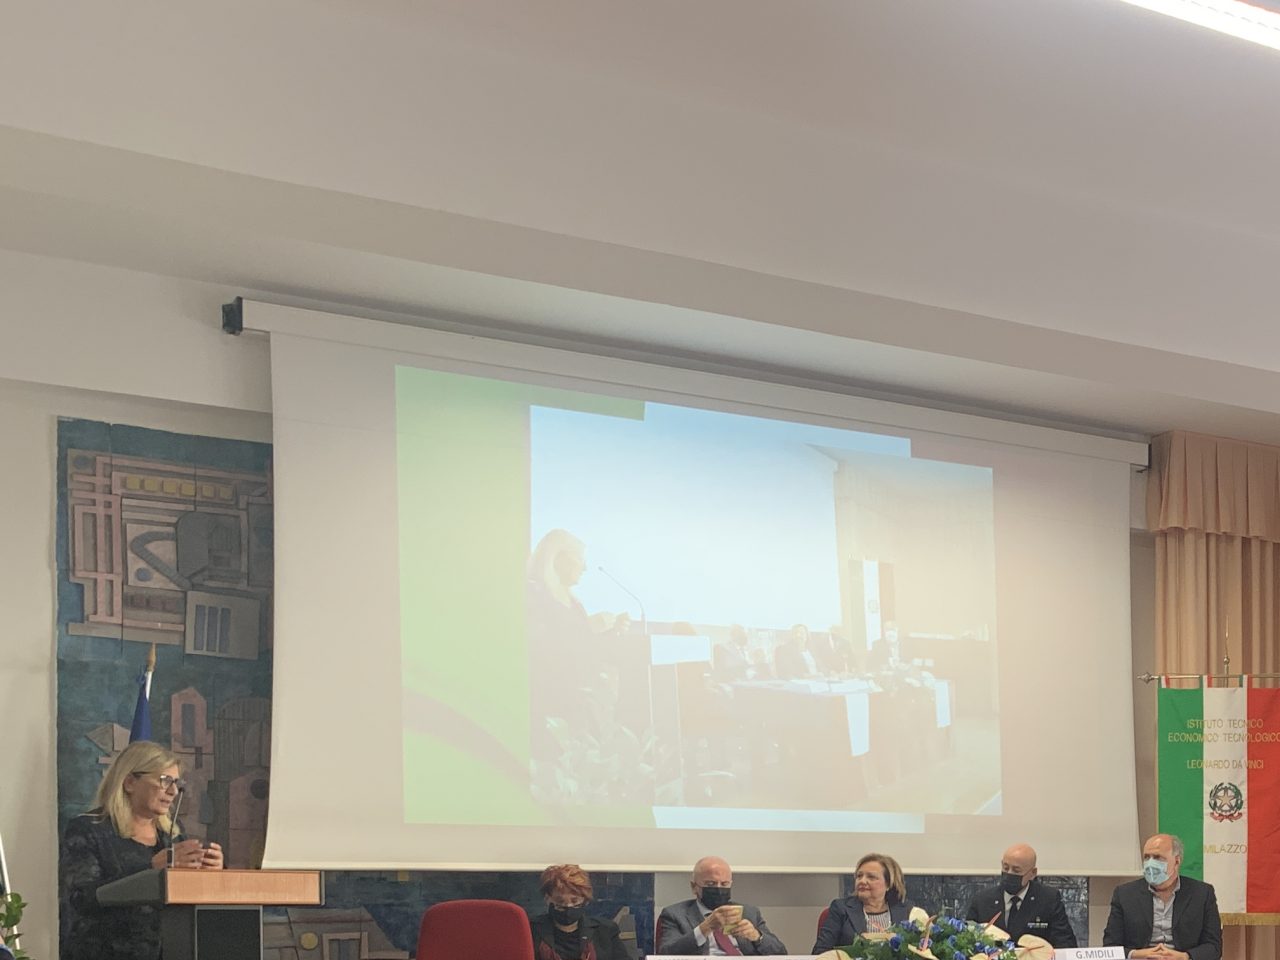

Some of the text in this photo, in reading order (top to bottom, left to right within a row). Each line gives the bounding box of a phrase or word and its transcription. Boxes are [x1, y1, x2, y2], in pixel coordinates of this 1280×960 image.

[1186, 718, 1264, 729] ISTITUTO TECNICO
[1167, 732, 1219, 743] ECONOMICO
[1186, 759, 1264, 769] LEONARDO DA VINCI
[1203, 844, 1248, 854] MILAZZO
[1075, 949, 1115, 960] G.MIDILI
